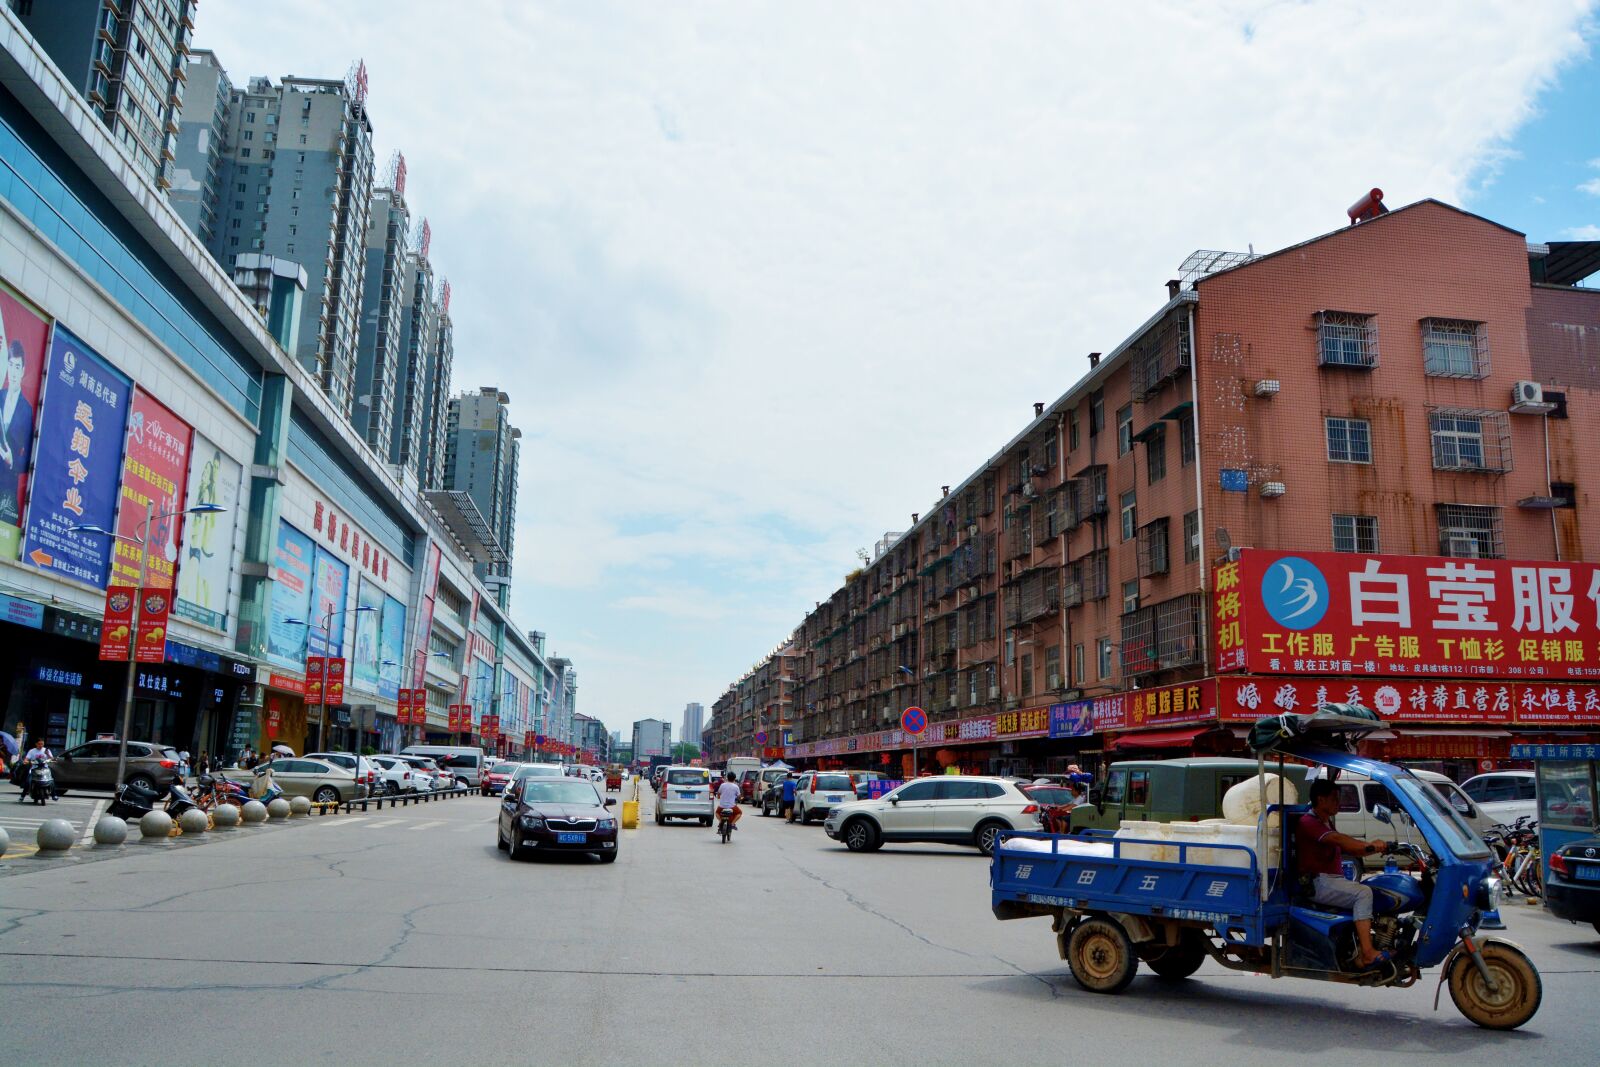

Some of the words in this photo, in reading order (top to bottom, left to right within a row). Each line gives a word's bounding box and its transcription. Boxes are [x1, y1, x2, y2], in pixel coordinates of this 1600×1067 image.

[1216, 561, 1244, 650] 麻将机
[1349, 559, 1600, 633] 白莹服
[1262, 632, 1335, 657] 工作服
[1350, 634, 1421, 658] 广告服
[1437, 637, 1504, 661] T恤衫
[1518, 639, 1585, 662] 促销服
[1147, 685, 1200, 717] 婚嫁喜庆
[1409, 684, 1510, 711] 诗蒂直营店
[1015, 864, 1229, 897] 福田五星
